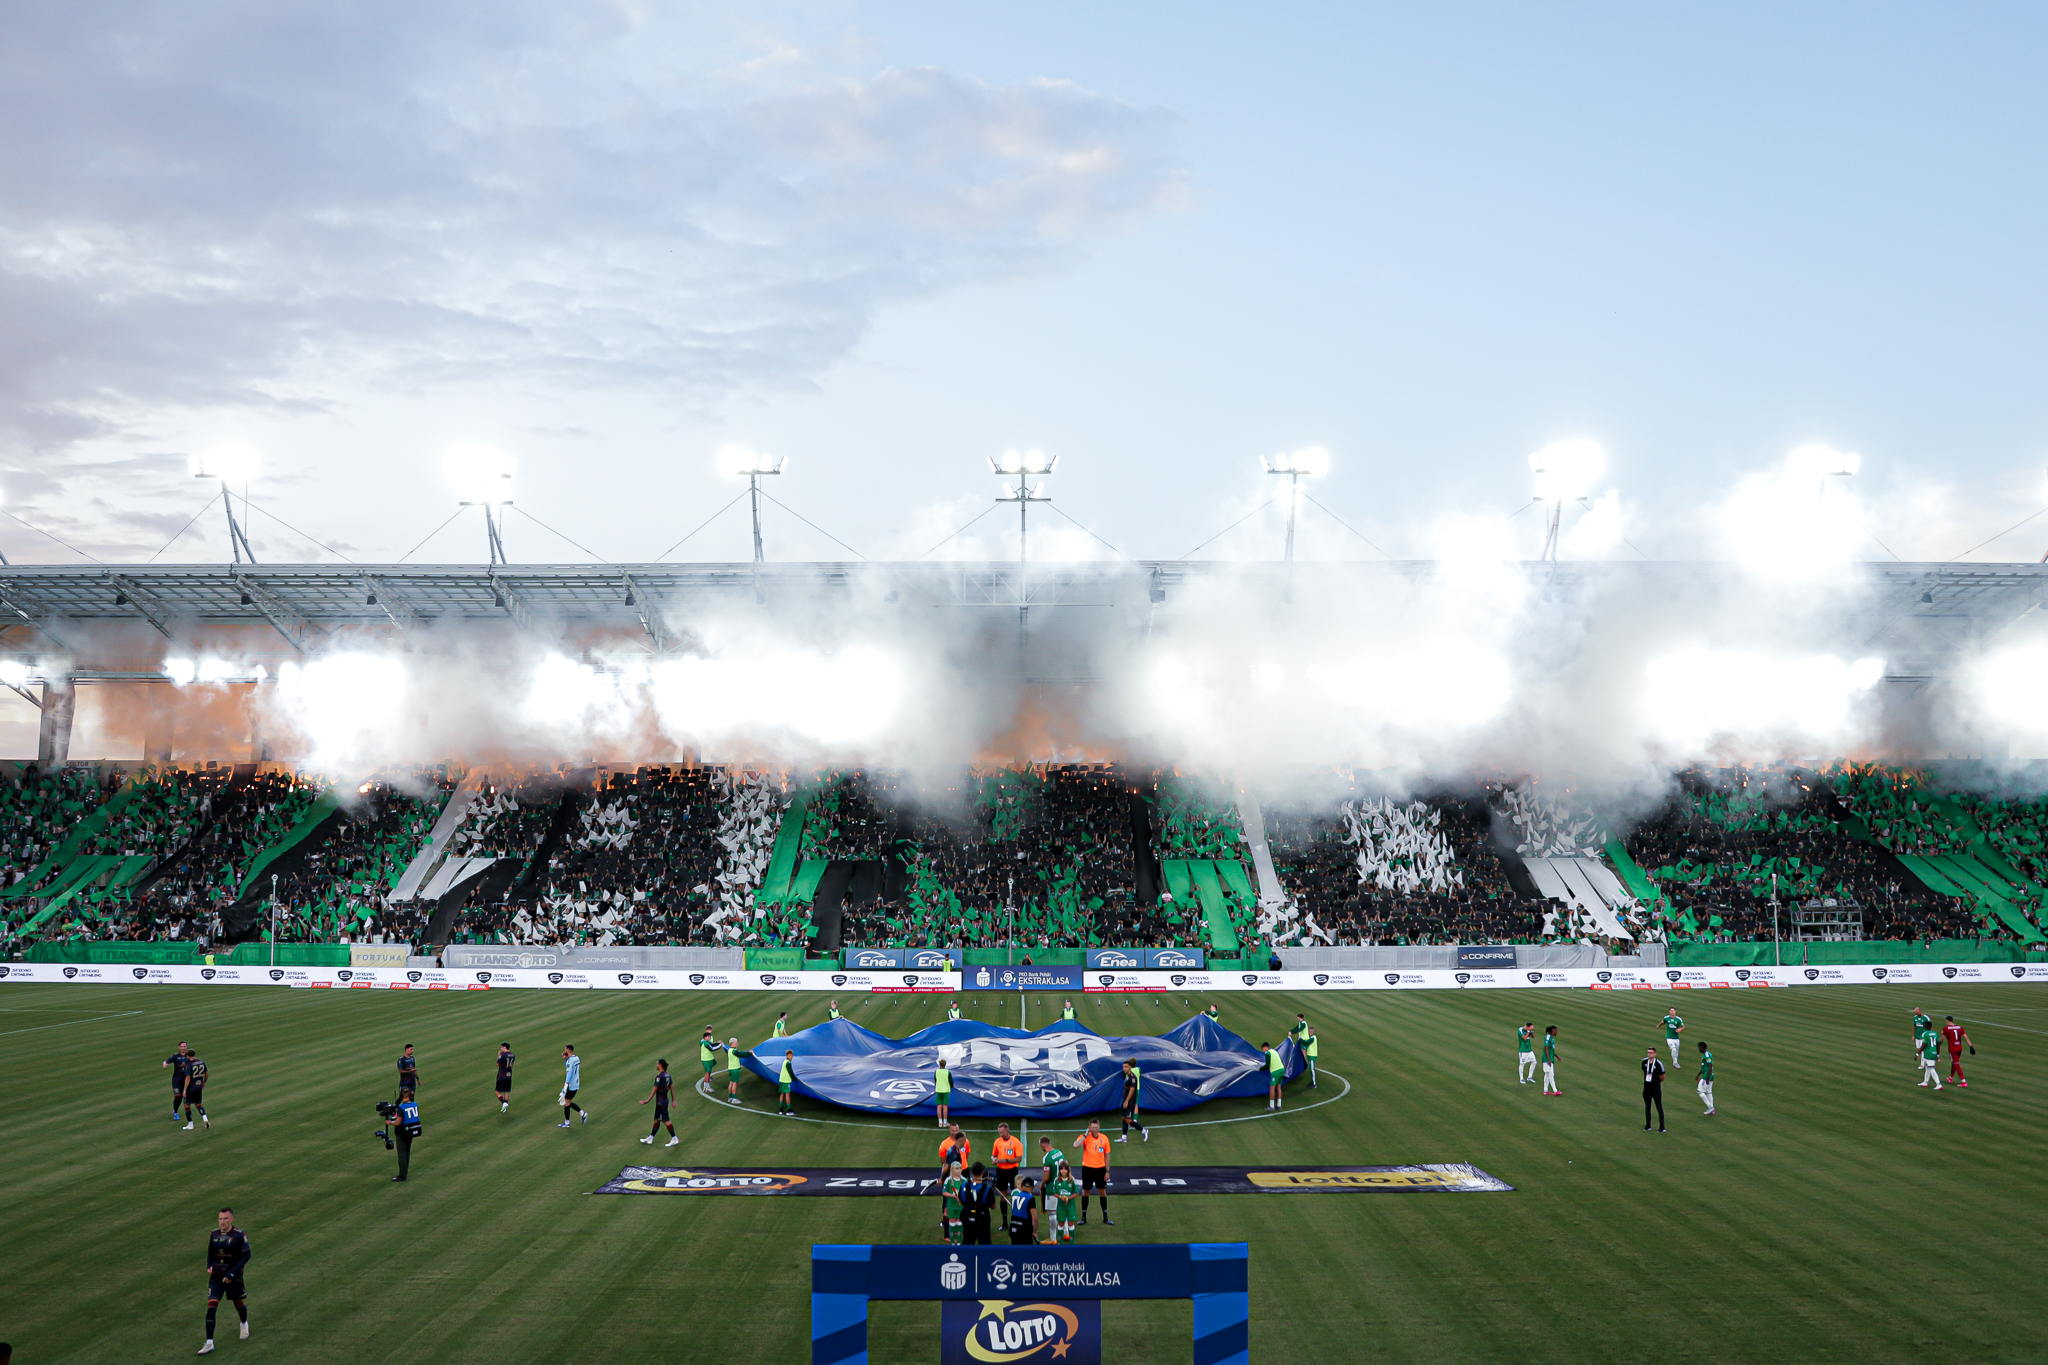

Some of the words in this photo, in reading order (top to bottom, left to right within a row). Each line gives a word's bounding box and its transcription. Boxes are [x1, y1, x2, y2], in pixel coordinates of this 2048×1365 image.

[859, 956, 896, 967] Enea
[1100, 957, 1138, 967] Enea
[1159, 957, 1196, 967] Enea
[192, 1065, 205, 1078] 22
[405, 1106, 418, 1118] TV
[665, 1177, 772, 1187] LOTTO
[1288, 1175, 1447, 1185] lotto.pl
[1022, 1263, 1039, 1271] PKO
[1041, 1263, 1060, 1271] Bank
[1063, 1263, 1085, 1271] Polski
[1022, 1272, 1121, 1286] EKSTRAKLASA
[988, 1314, 1056, 1350] LOTTO
